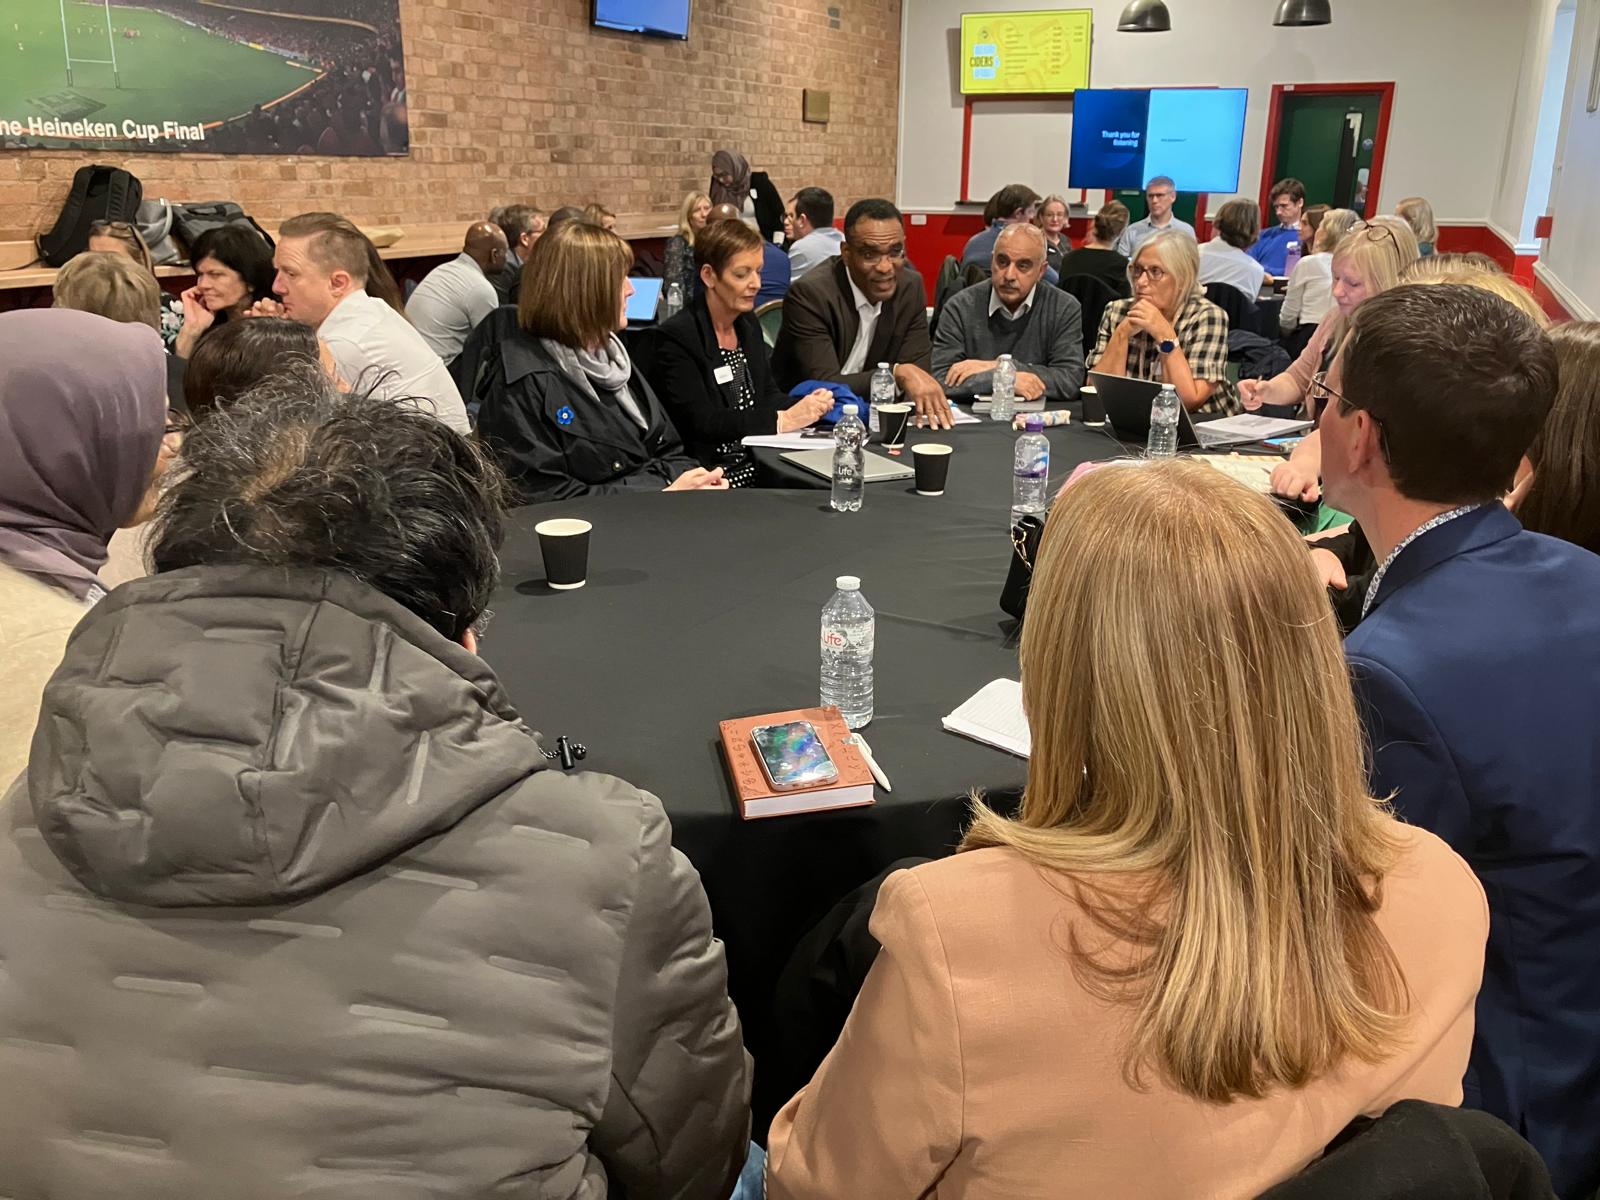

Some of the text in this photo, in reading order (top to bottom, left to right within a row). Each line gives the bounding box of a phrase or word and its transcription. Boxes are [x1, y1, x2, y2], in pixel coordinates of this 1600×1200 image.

[969, 56, 994, 67] CIDERS
[27, 116, 118, 138] Heineken
[122, 119, 159, 143] Cup
[163, 121, 205, 141] Final
[1102, 130, 1119, 138] Thank
